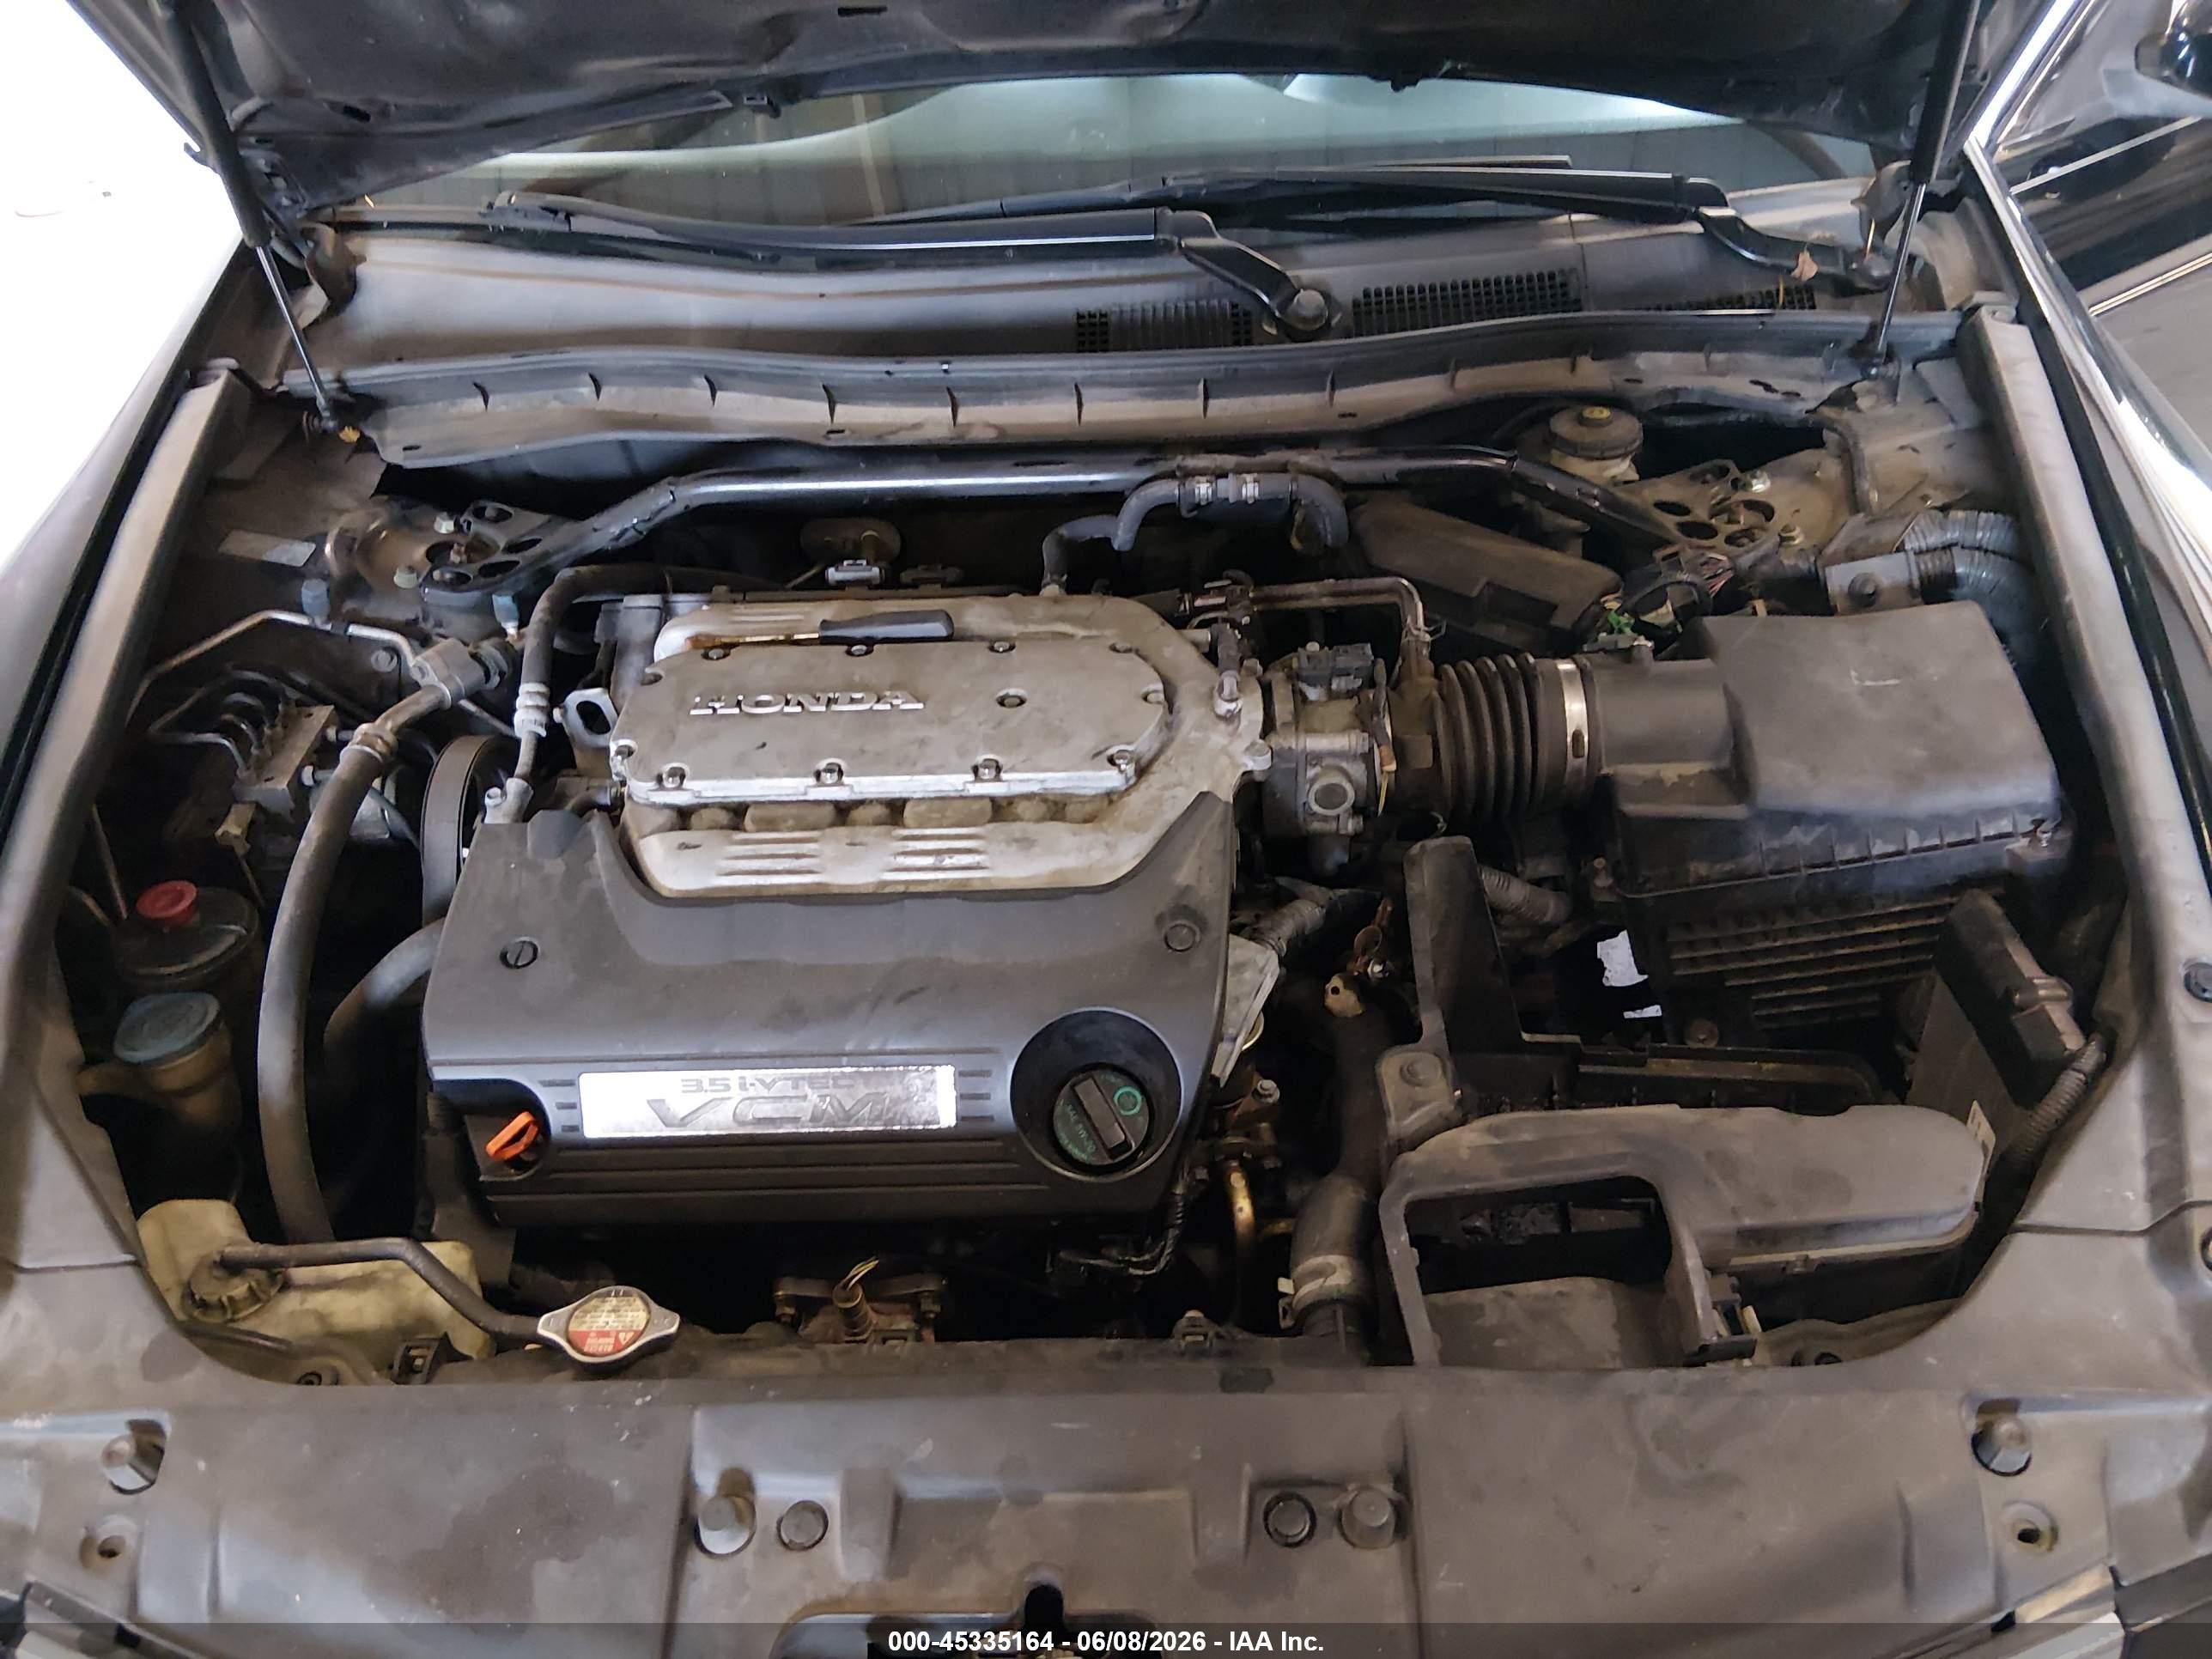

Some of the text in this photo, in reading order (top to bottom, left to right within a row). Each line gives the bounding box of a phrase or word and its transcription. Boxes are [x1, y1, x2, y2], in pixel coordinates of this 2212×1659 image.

[689, 690, 925, 715] HONDA
[680, 1077, 732, 1093] 3.5
[646, 1092, 889, 1128] VCM
